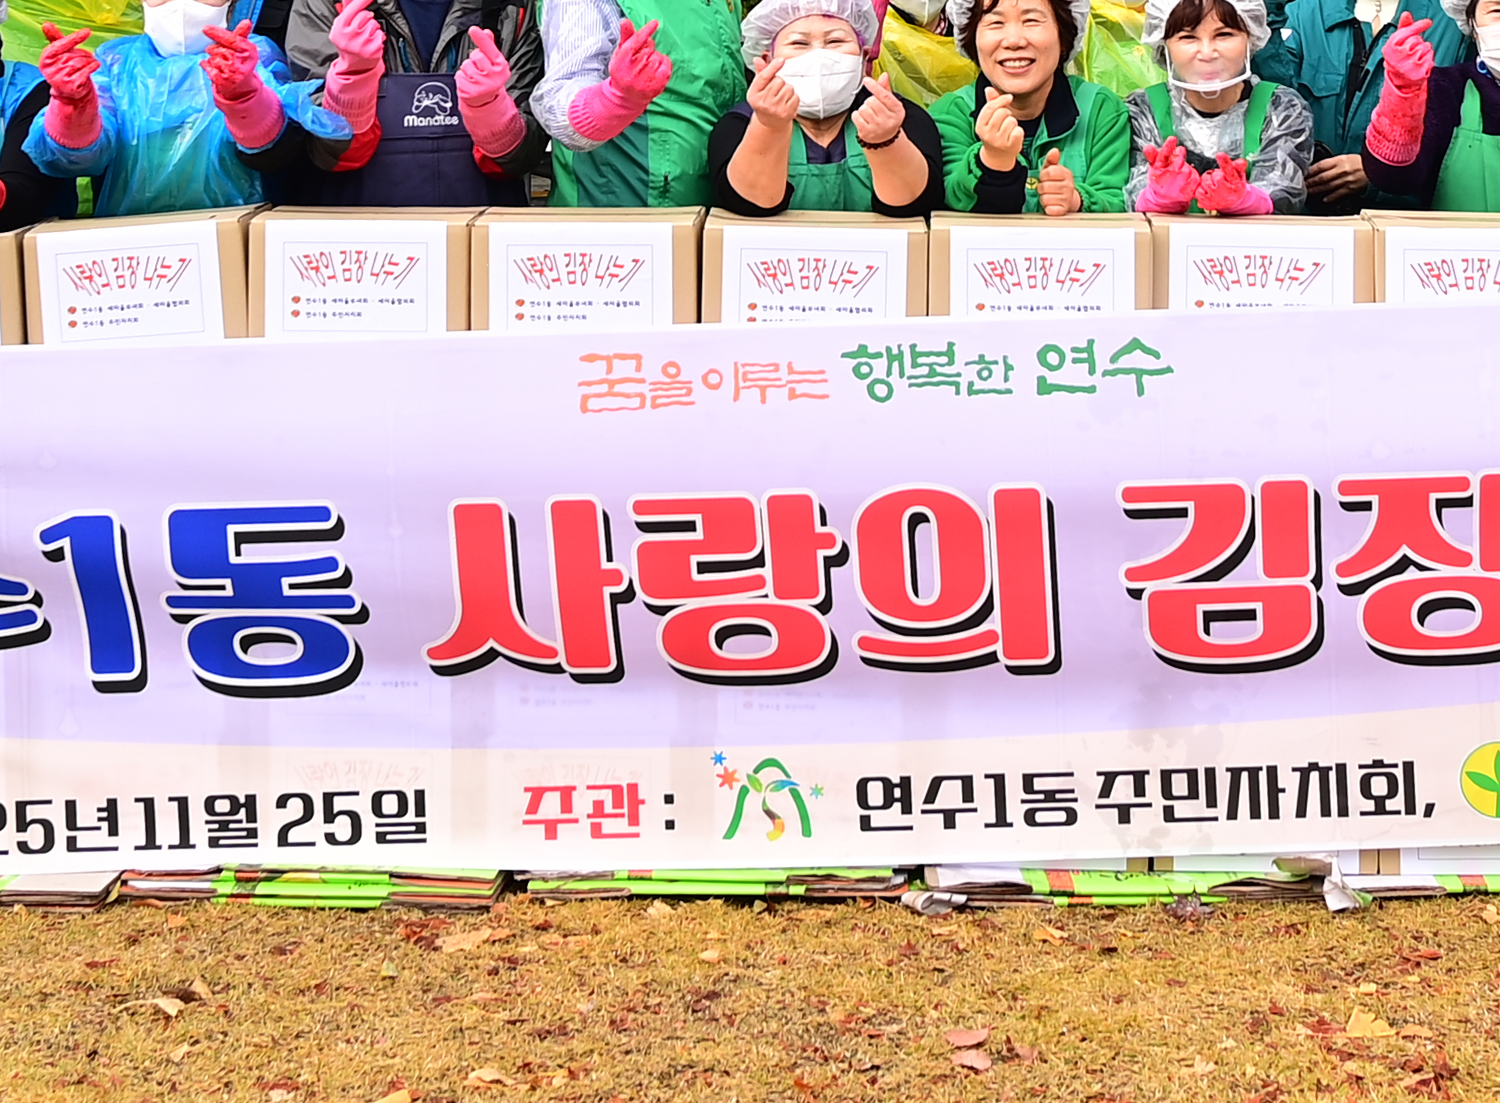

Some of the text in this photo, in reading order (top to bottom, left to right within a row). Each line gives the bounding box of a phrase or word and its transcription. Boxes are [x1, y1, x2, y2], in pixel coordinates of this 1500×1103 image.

[62, 256, 192, 296] 사랑의 김장 나누기
[290, 250, 420, 290] 사랑의 김장 나누기
[513, 252, 645, 292] 사랑의 김장 나누기
[747, 257, 880, 298] 사랑의 김장 나누기
[973, 256, 1106, 296] 사랑의 김장 나누기
[1193, 254, 1326, 295] 사랑의 김장 나누기
[1410, 259, 1460, 295] 사랑의
[1461, 258, 1491, 292] 김장
[841, 341, 1015, 404] 행복한
[1036, 337, 1175, 397] 연수
[422, 478, 1063, 686] 사랑의
